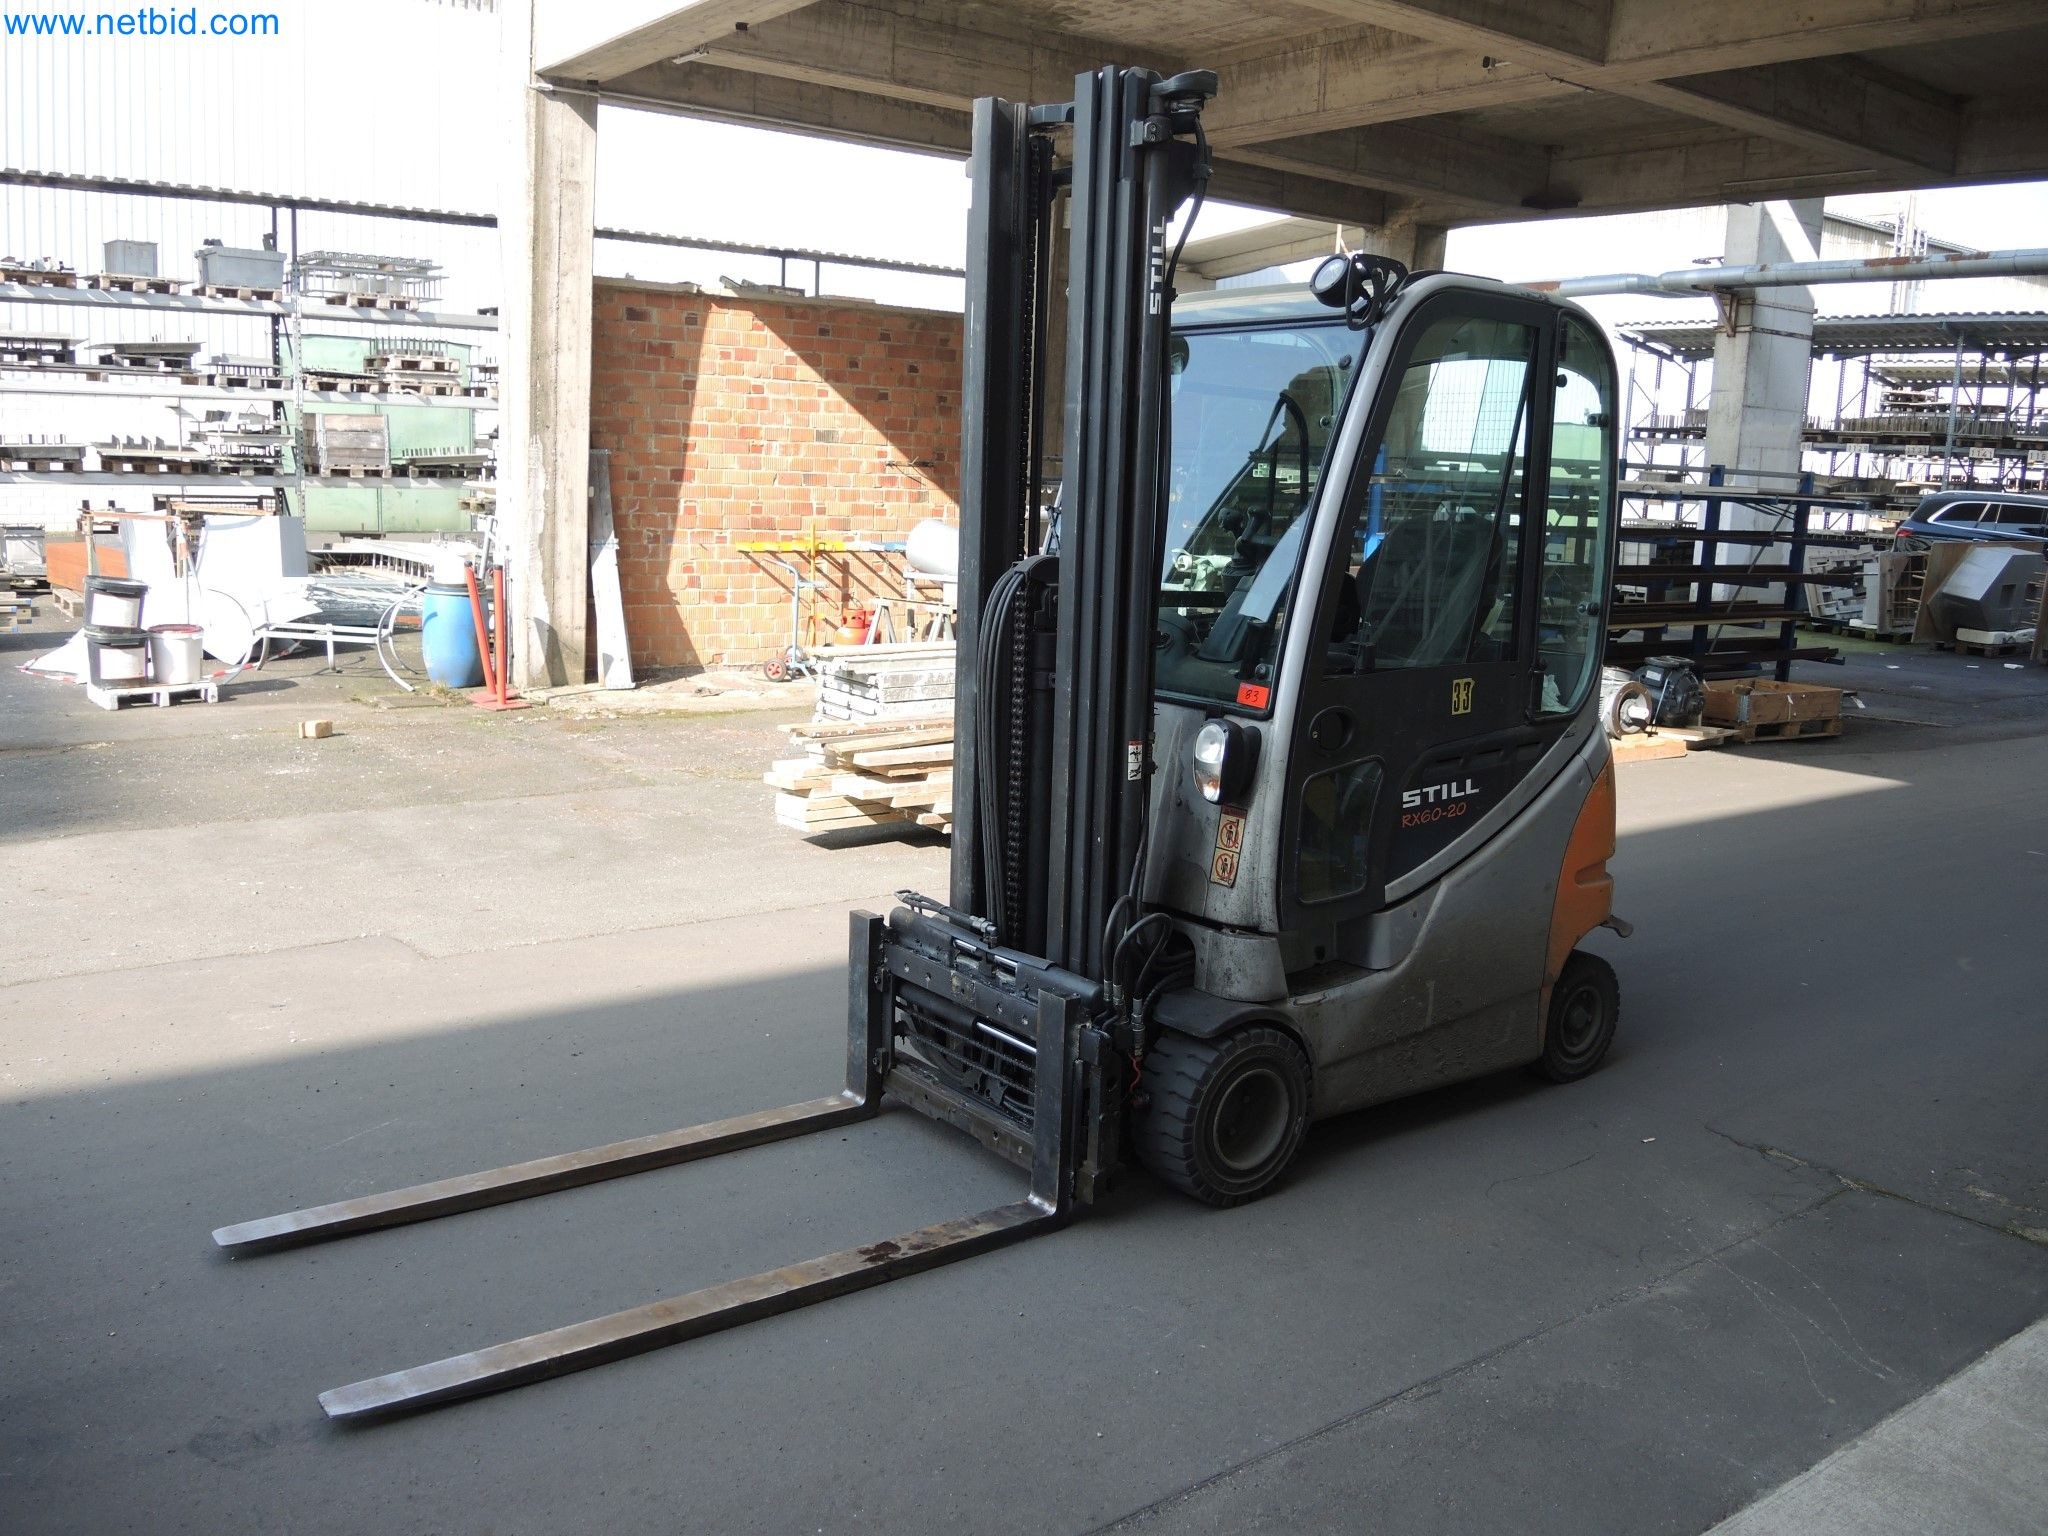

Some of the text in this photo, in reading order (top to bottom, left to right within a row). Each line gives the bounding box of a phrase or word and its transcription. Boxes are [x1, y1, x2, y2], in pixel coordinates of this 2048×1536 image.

[1149, 215, 1165, 315] STILL
[1245, 689, 1260, 703] 83
[1454, 681, 1471, 712] 33
[1402, 778, 1480, 808] STILL
[1402, 802, 1467, 828] RX60-20
